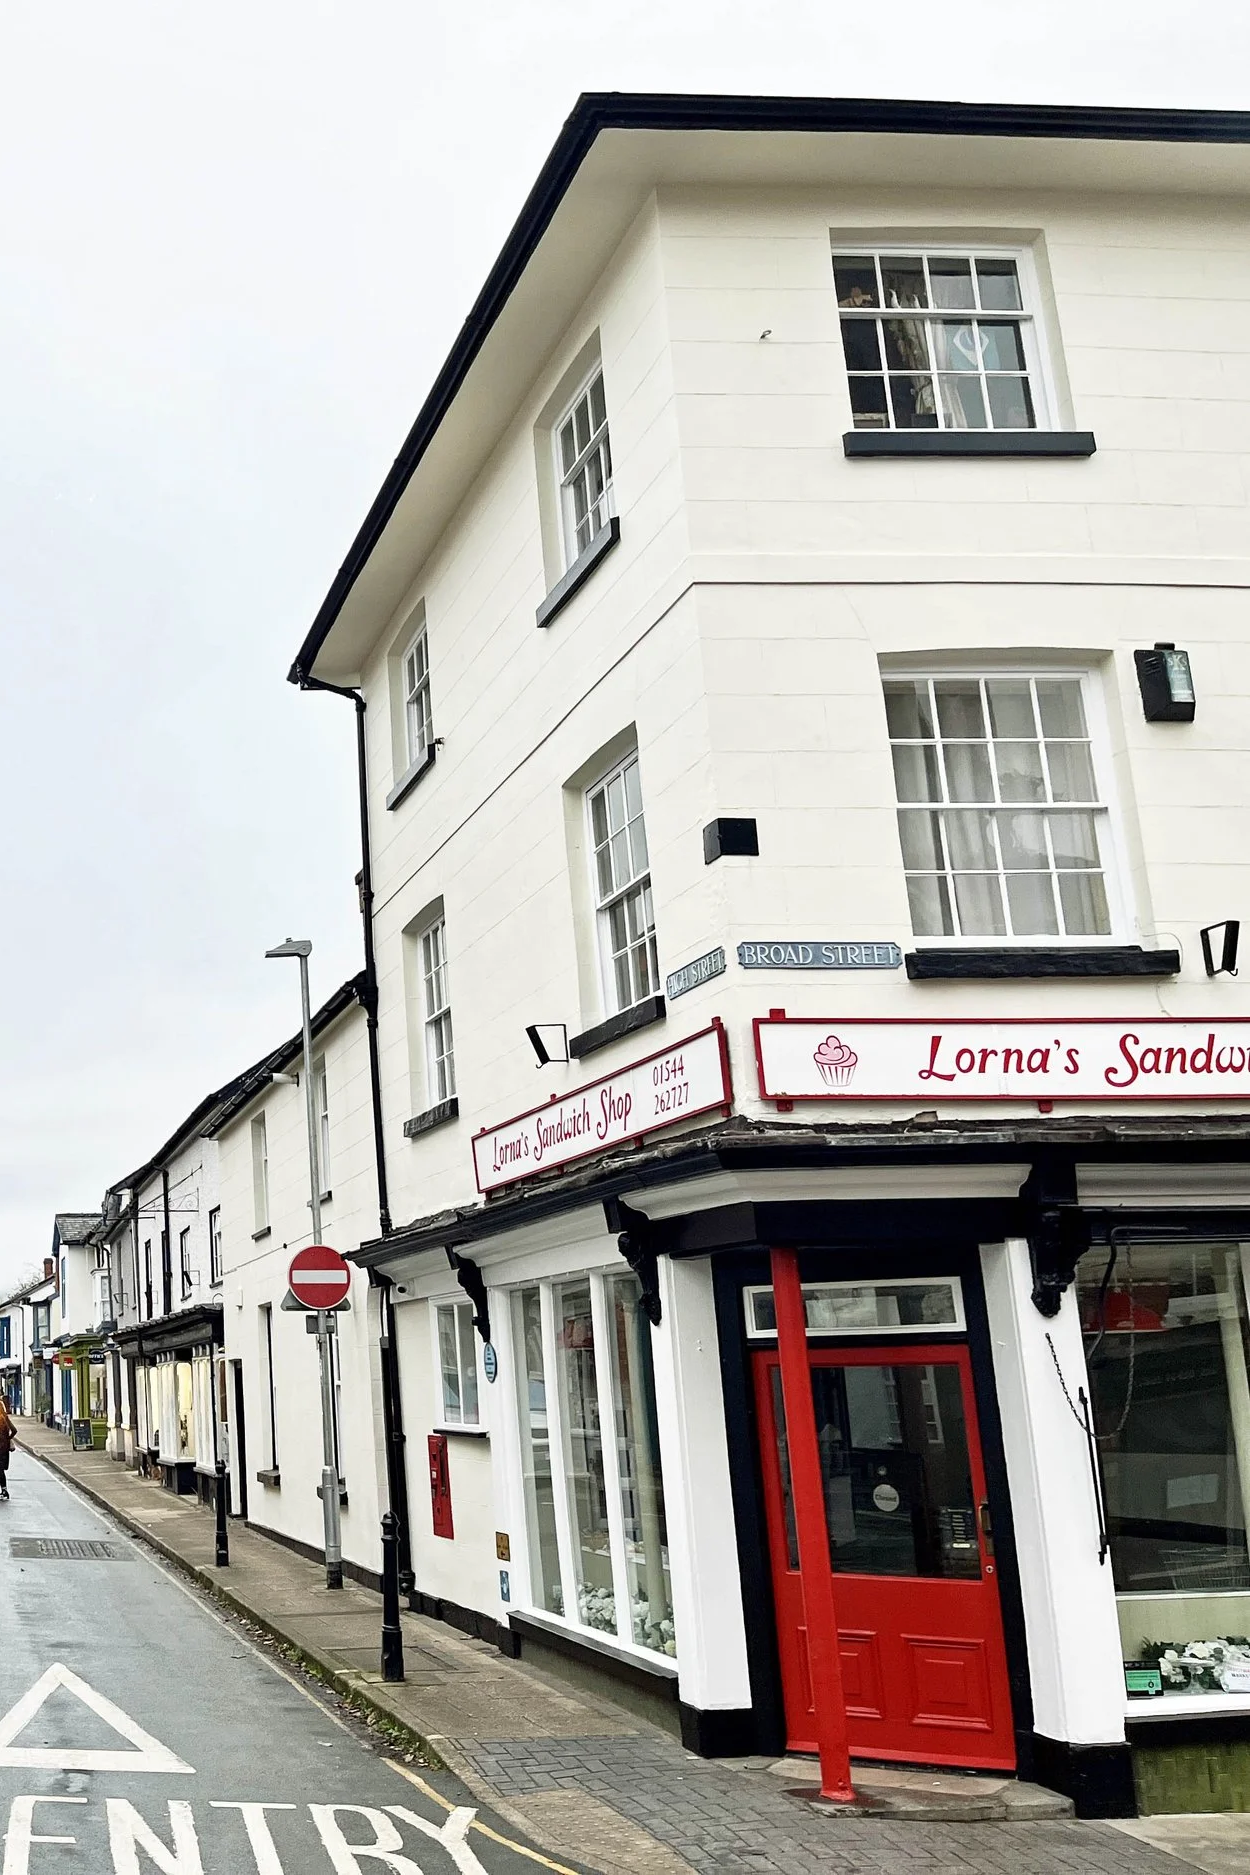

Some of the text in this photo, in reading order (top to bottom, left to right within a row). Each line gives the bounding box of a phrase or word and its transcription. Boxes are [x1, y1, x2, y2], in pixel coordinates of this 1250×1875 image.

[667, 950, 724, 998] HIGH STREET
[744, 945, 894, 965] BROAD STREET
[652, 1054, 685, 1087] 01544
[918, 1035, 1080, 1082] Lorna's
[654, 1081, 689, 1116] 262727
[493, 1085, 632, 1173] Lorna's Sandwich Shop
[2, 1795, 478, 1875] ENTRY
